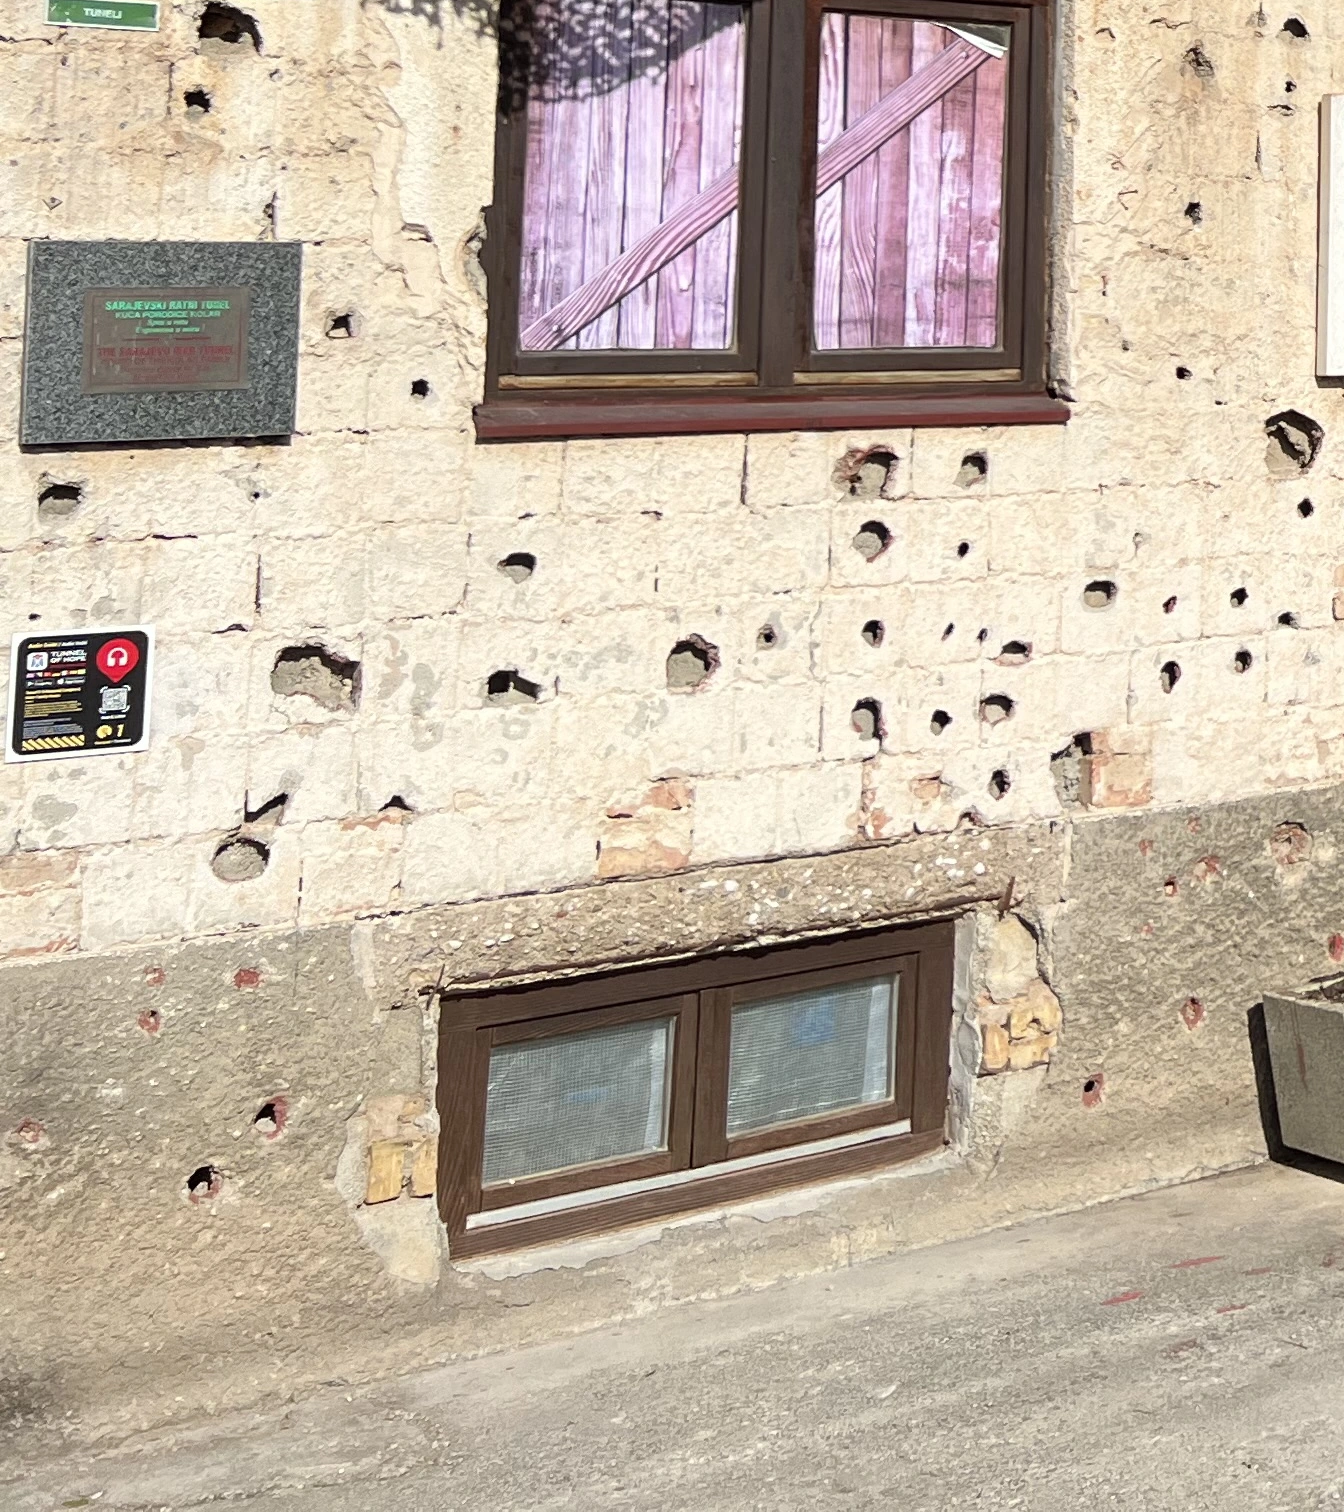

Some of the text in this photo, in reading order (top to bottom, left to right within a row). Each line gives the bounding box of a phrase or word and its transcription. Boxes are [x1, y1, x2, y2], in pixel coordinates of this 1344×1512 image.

[83, 7, 122, 19] TUNELI
[105, 301, 166, 310] SARAJEVSKI
[117, 724, 125, 737] 1
